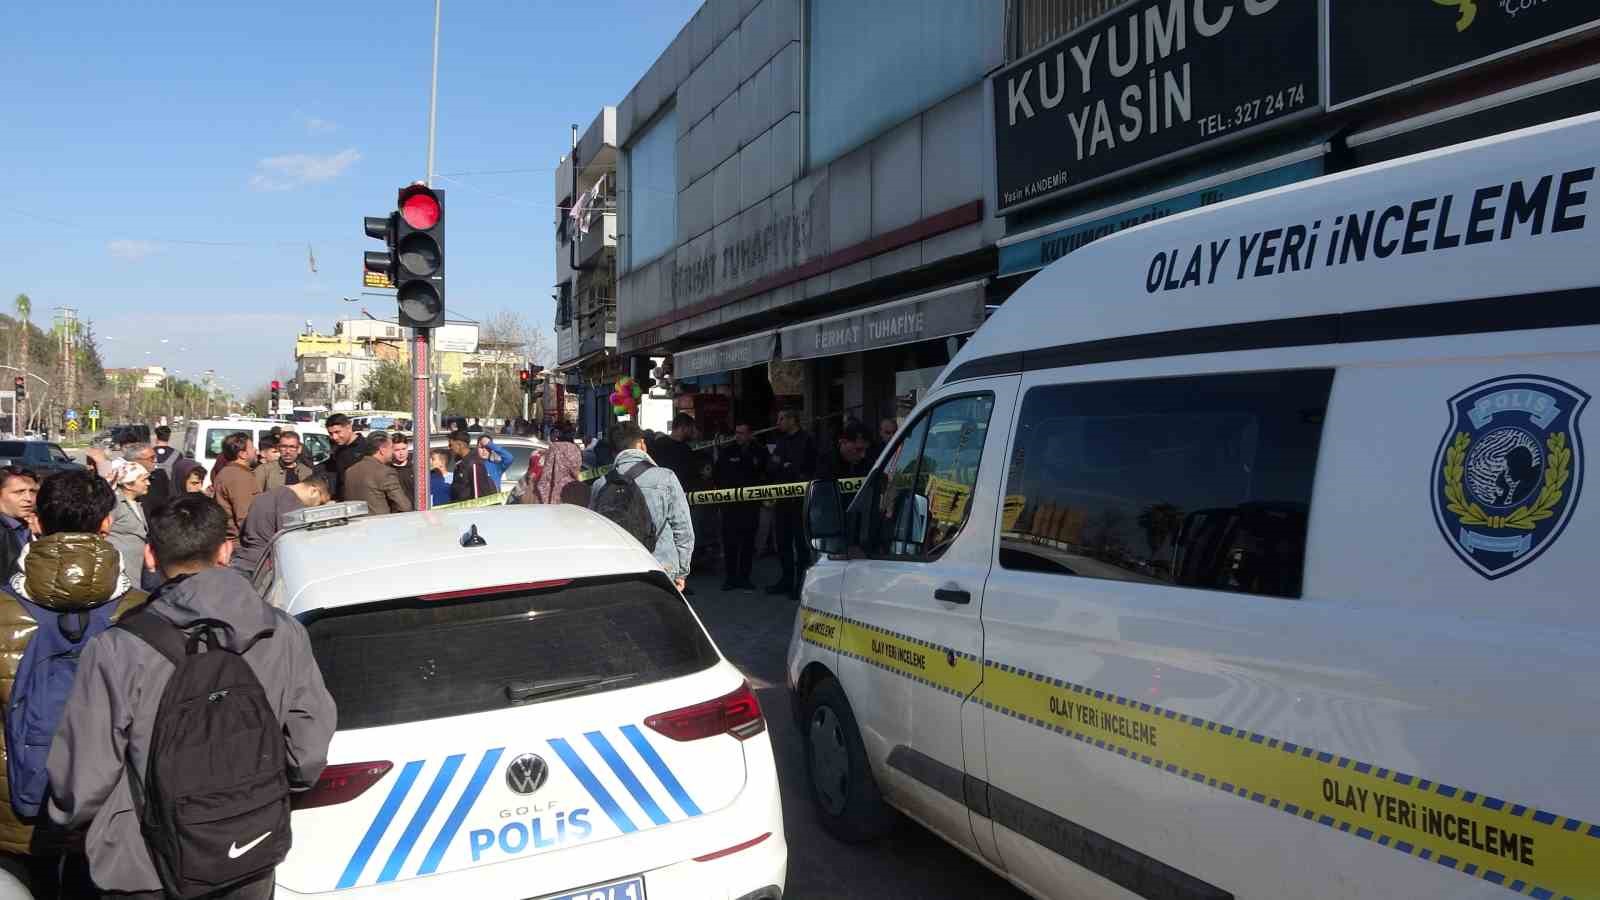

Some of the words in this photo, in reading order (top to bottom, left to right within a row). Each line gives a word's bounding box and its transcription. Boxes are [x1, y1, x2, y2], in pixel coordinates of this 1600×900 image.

[1008, 0, 1279, 126] KUYUMC
[1067, 62, 1191, 160] YASİN
[1199, 117, 1232, 136] TEL:
[1234, 100, 1262, 125] 327
[1265, 90, 1284, 112] 24
[1287, 83, 1305, 107] 74
[1145, 239, 1229, 294] OLAY
[1049, 695, 1074, 720] OLAY
[499, 800, 559, 818] GOLF
[1322, 778, 1369, 809] OLAY
